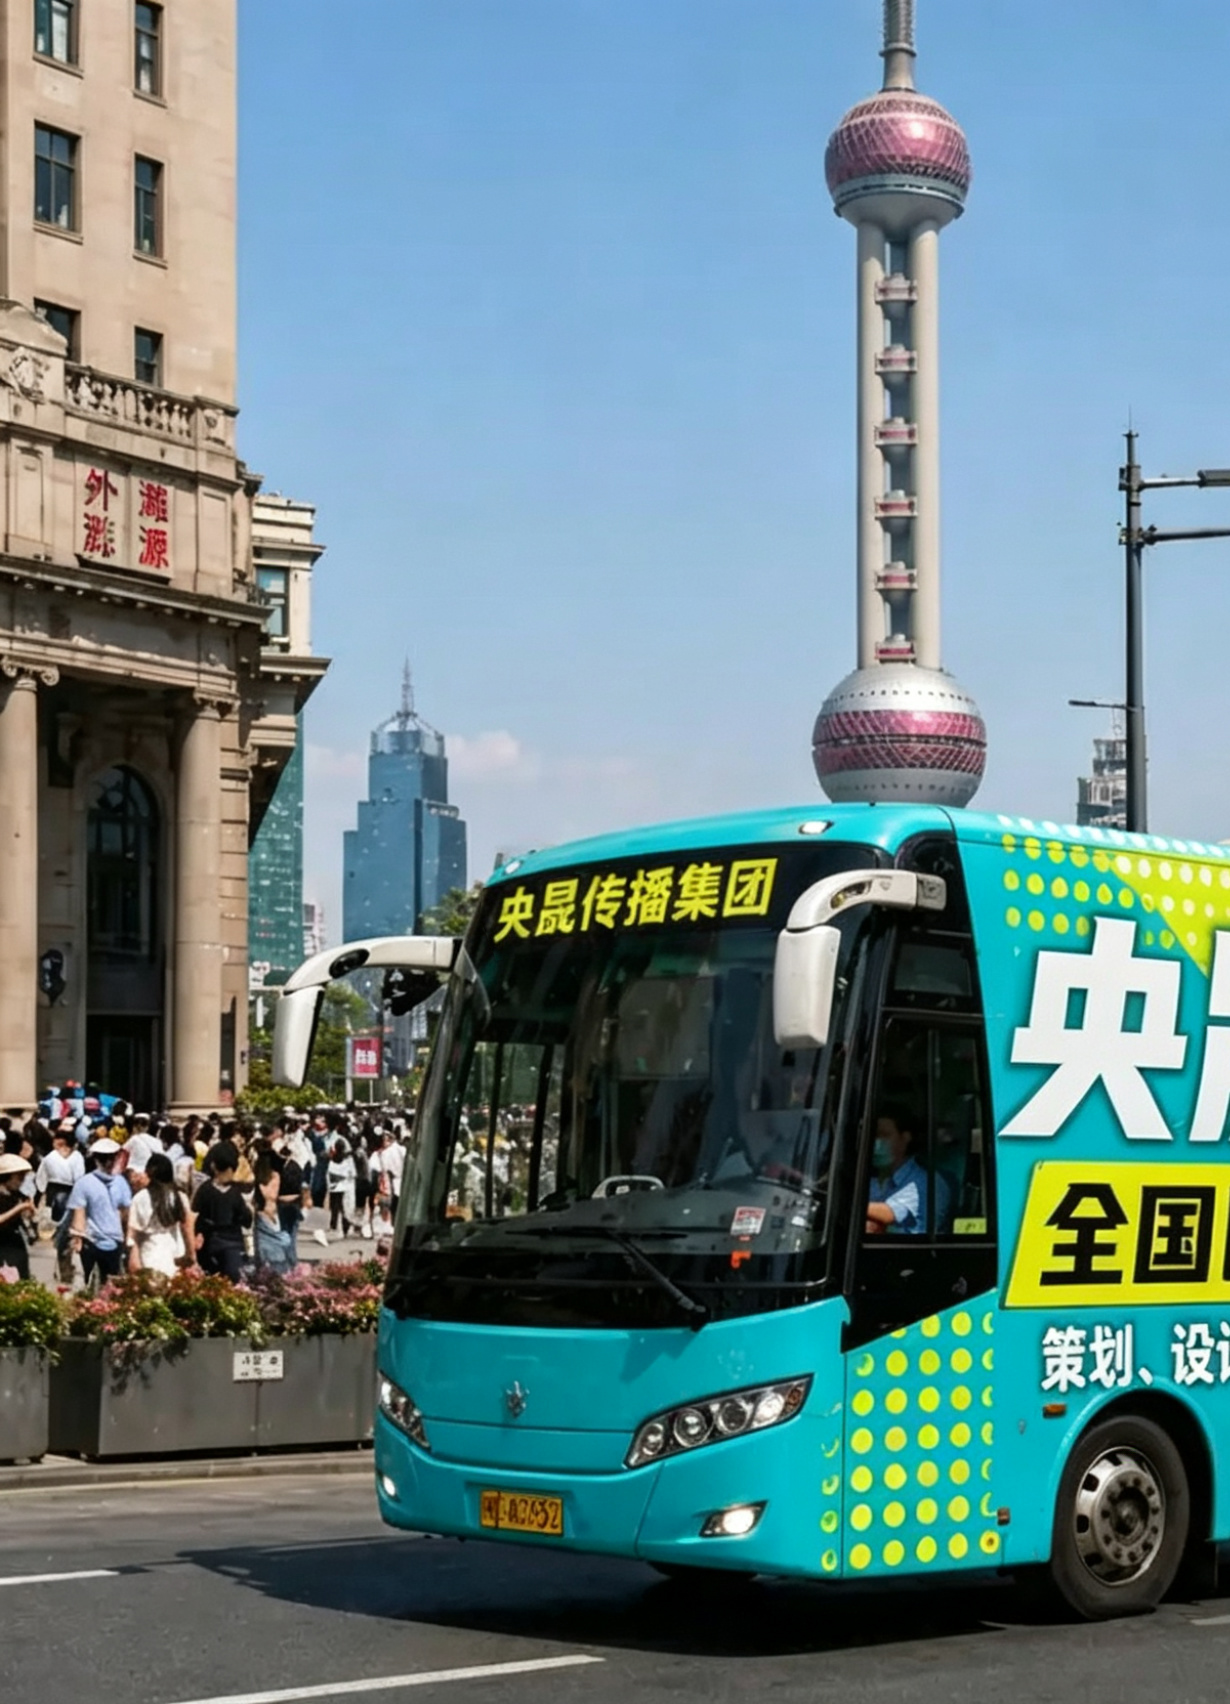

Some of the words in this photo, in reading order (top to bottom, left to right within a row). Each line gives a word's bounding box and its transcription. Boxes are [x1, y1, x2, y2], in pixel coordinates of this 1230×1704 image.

[494, 858, 778, 943] 央晟传播集团
